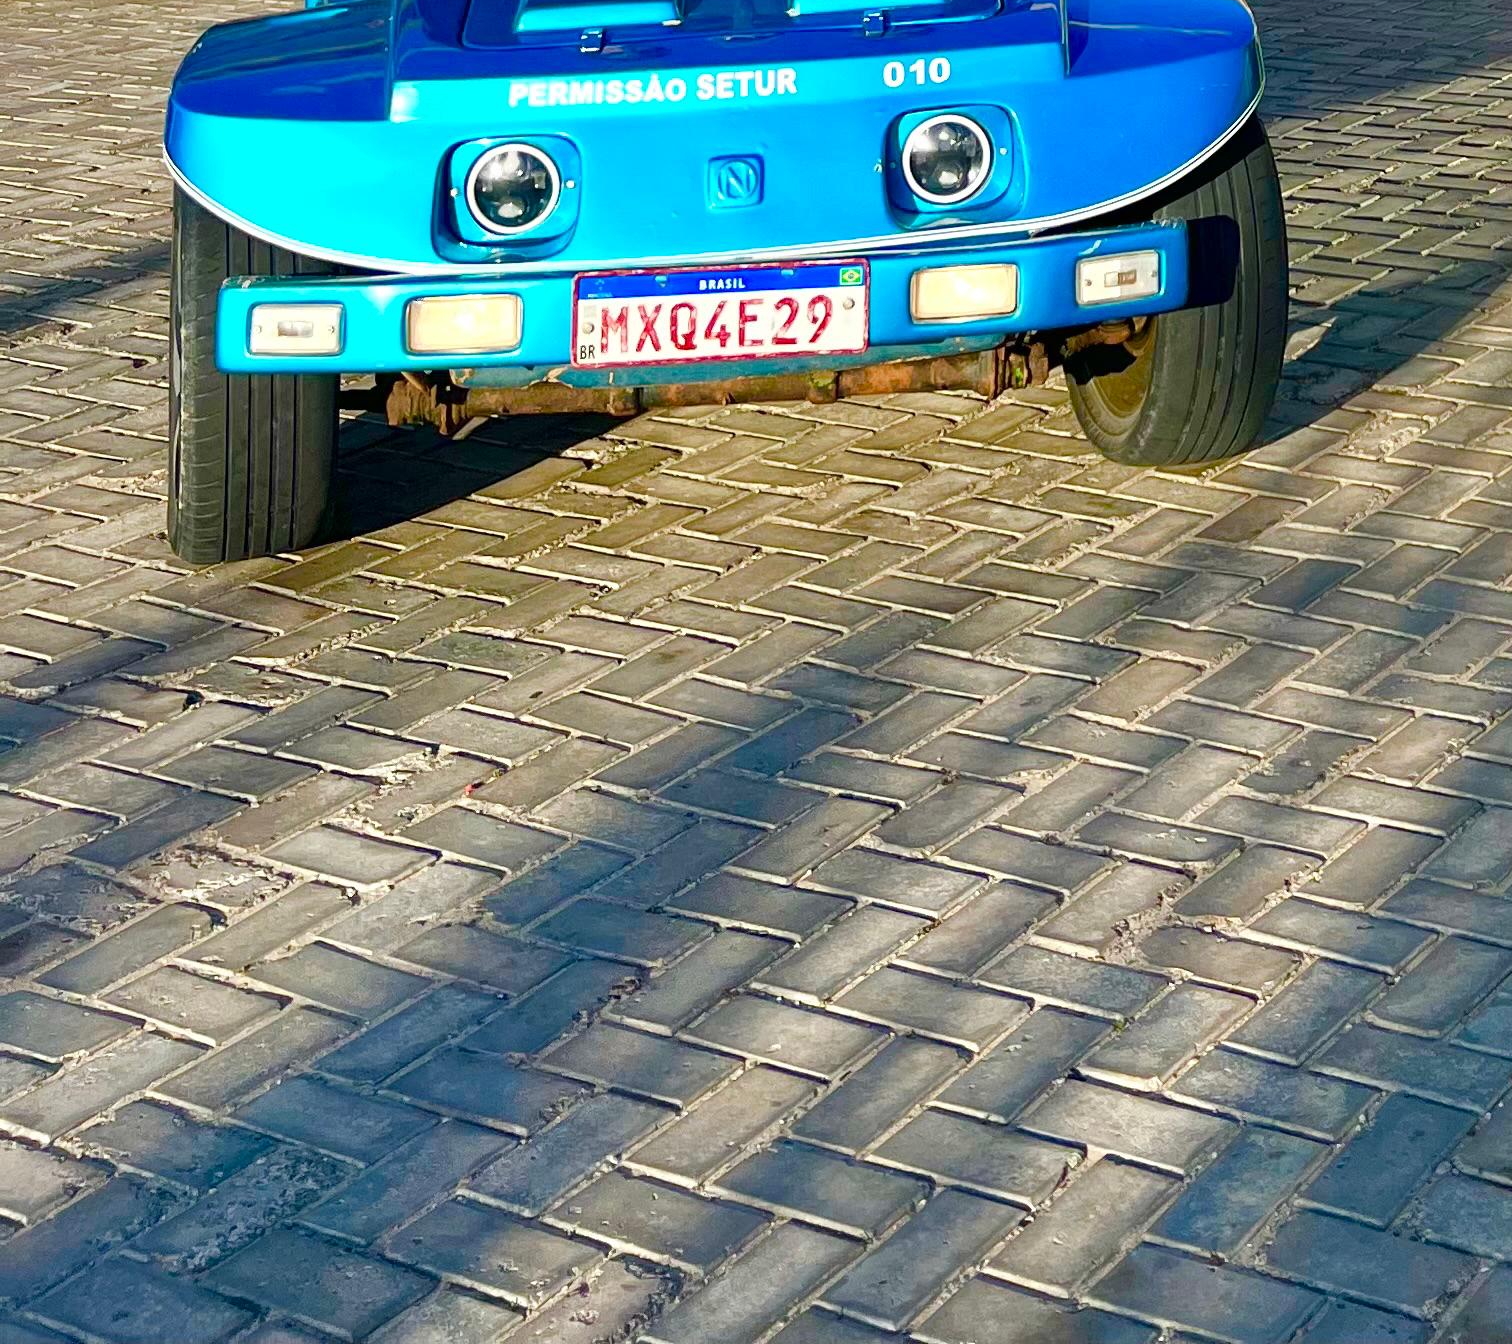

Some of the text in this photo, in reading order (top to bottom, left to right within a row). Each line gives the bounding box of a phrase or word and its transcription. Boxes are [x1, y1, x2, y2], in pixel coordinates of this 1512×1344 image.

[508, 57, 951, 107] PERMISSÃO SETUR 010
[699, 277, 746, 291] BRASIL
[600, 294, 833, 353] MXQ4E29
[580, 345, 595, 360] BR
